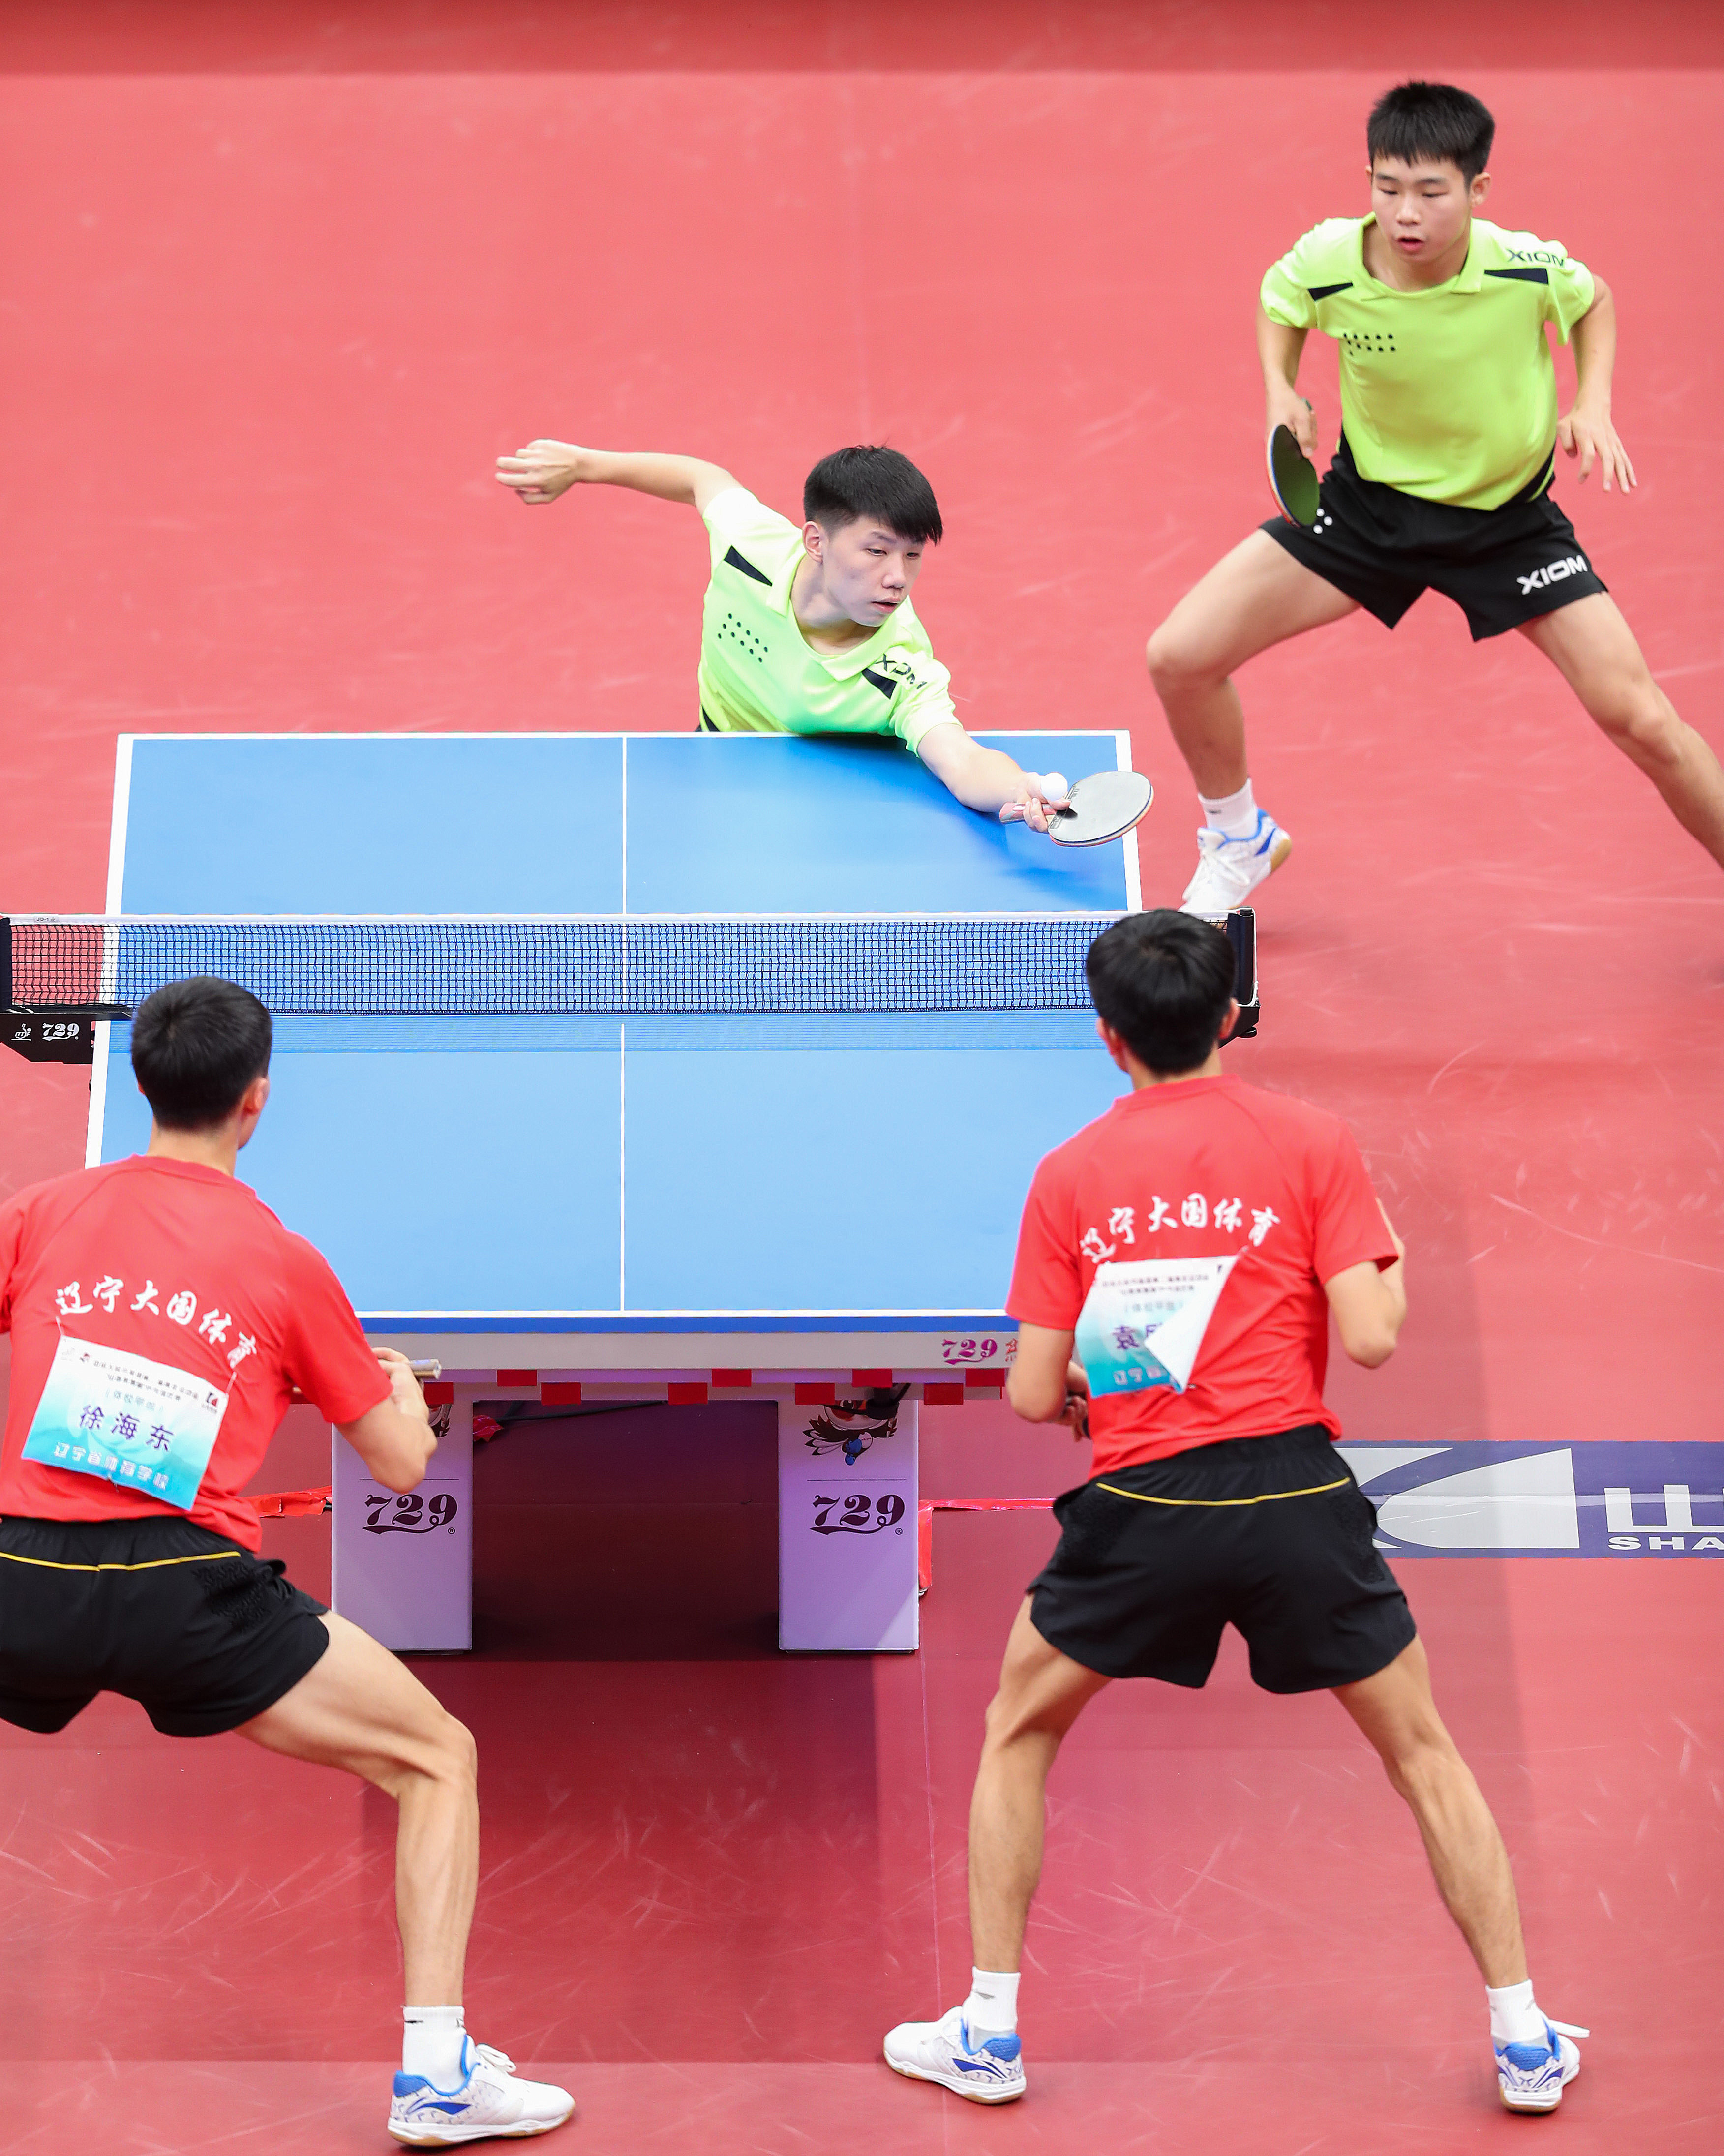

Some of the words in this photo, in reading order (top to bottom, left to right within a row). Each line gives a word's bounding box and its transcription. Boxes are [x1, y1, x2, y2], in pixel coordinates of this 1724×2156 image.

[1516, 555, 1588, 595] XIOM
[42, 1023, 80, 1041] 729
[942, 1339, 998, 1365] 729
[79, 1404, 174, 1451] 徐海东
